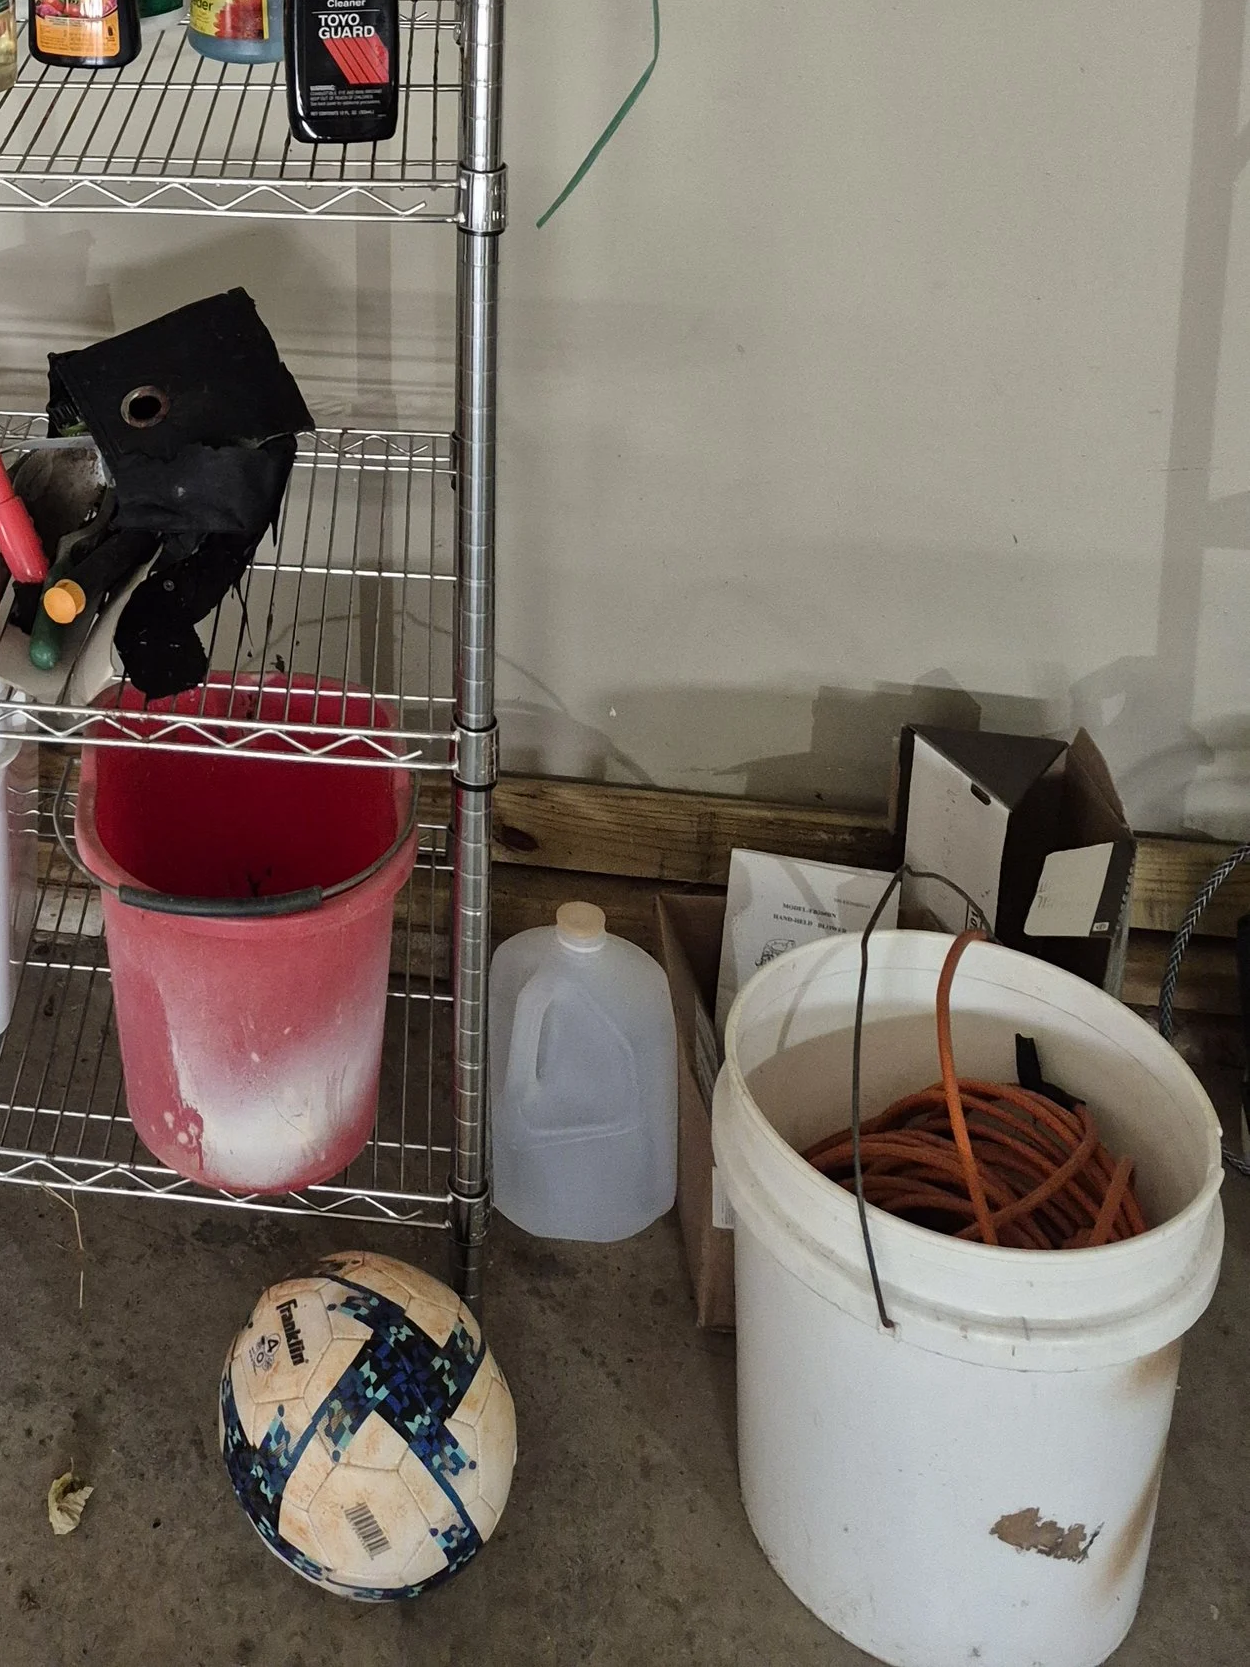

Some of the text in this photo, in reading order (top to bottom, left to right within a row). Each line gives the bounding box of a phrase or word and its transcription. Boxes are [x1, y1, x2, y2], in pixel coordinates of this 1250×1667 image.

[327, 0, 366, 8] Cleaner
[318, 13, 360, 26] TOYO
[318, 25, 375, 39] GUARD
[773, 913, 813, 926] HAND-HELD
[276, 1298, 305, 1366] Franklin
